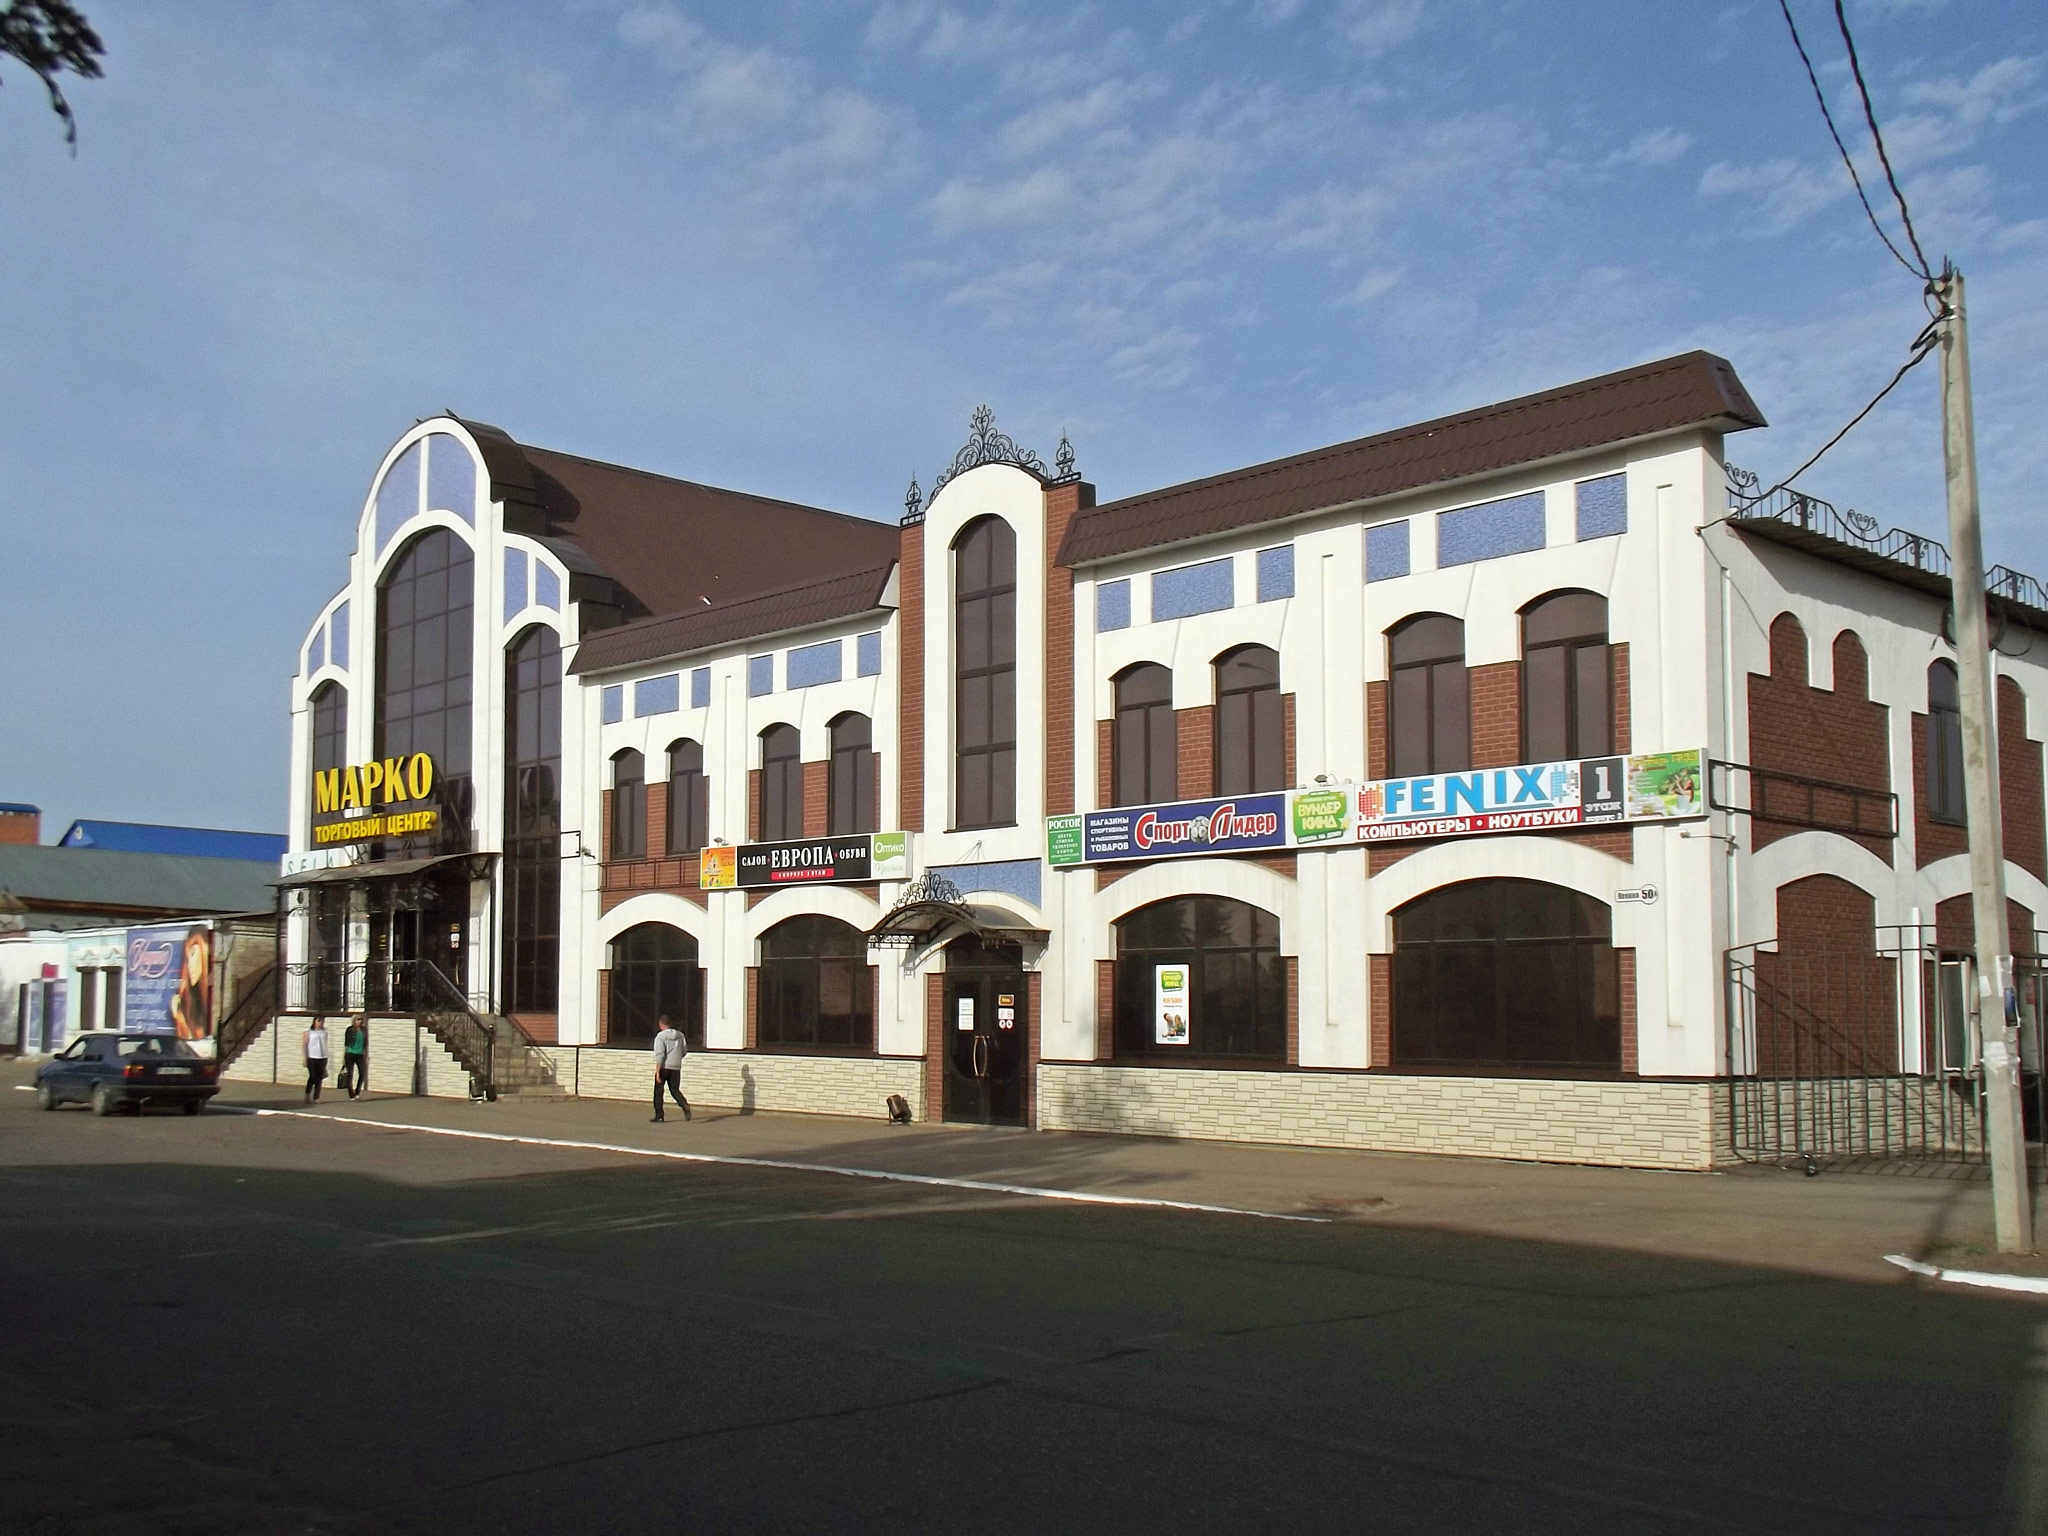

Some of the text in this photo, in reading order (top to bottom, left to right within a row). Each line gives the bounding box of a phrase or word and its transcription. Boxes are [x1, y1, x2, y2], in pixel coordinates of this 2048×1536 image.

[315, 752, 433, 814] МАРКО
[1384, 766, 1550, 816] FENIX
[1595, 766, 1612, 800] 1
[1090, 817, 1129, 826] МАГАЗИНЫ
[1298, 801, 1341, 817] ВУНДЕР
[1302, 814, 1338, 830] КИНД
[315, 811, 438, 843] ТОРГОВЫЙ ЦЕНТР
[1048, 818, 1081, 830] РОСТОК
[1135, 803, 1277, 849] Спорт Лидер
[1359, 808, 1578, 839] КОМПЬЮТЕРЫ НОУТБУКИ
[741, 855, 766, 867] САЛОН
[771, 845, 834, 869] ЕВРОПА
[839, 847, 866, 860] ОБУВИ
[1090, 842, 1129, 852] ТОВАРОВ
